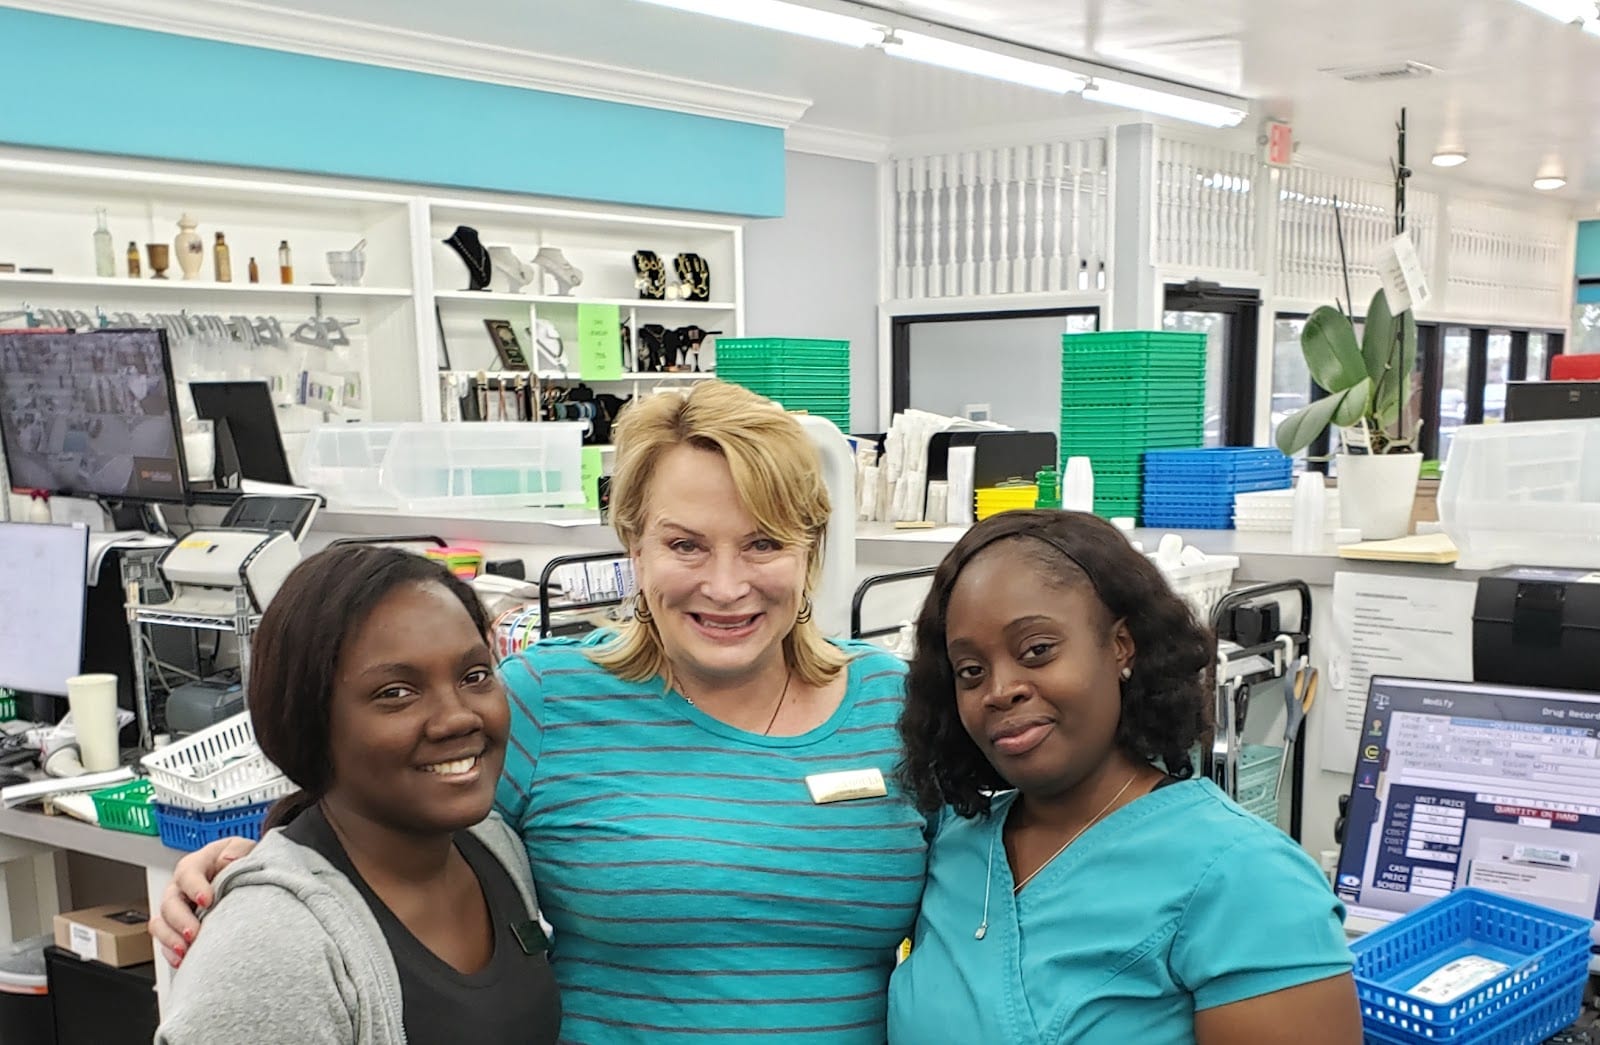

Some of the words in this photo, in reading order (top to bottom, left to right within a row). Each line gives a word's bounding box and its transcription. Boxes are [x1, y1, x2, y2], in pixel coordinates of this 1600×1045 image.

[1422, 698, 1454, 709] Modify
[1542, 707, 1564, 718] Drug
[1415, 795, 1437, 804] UNIT
[1440, 798, 1466, 808] PRICE
[1494, 804, 1537, 817] QUANTITY
[1540, 810, 1553, 819] ON
[1555, 811, 1580, 822] HAND
[1385, 828, 1406, 837] COST
[1384, 836, 1405, 846] COST
[1388, 863, 1410, 874] CASH
[1382, 871, 1408, 883] PRICE
